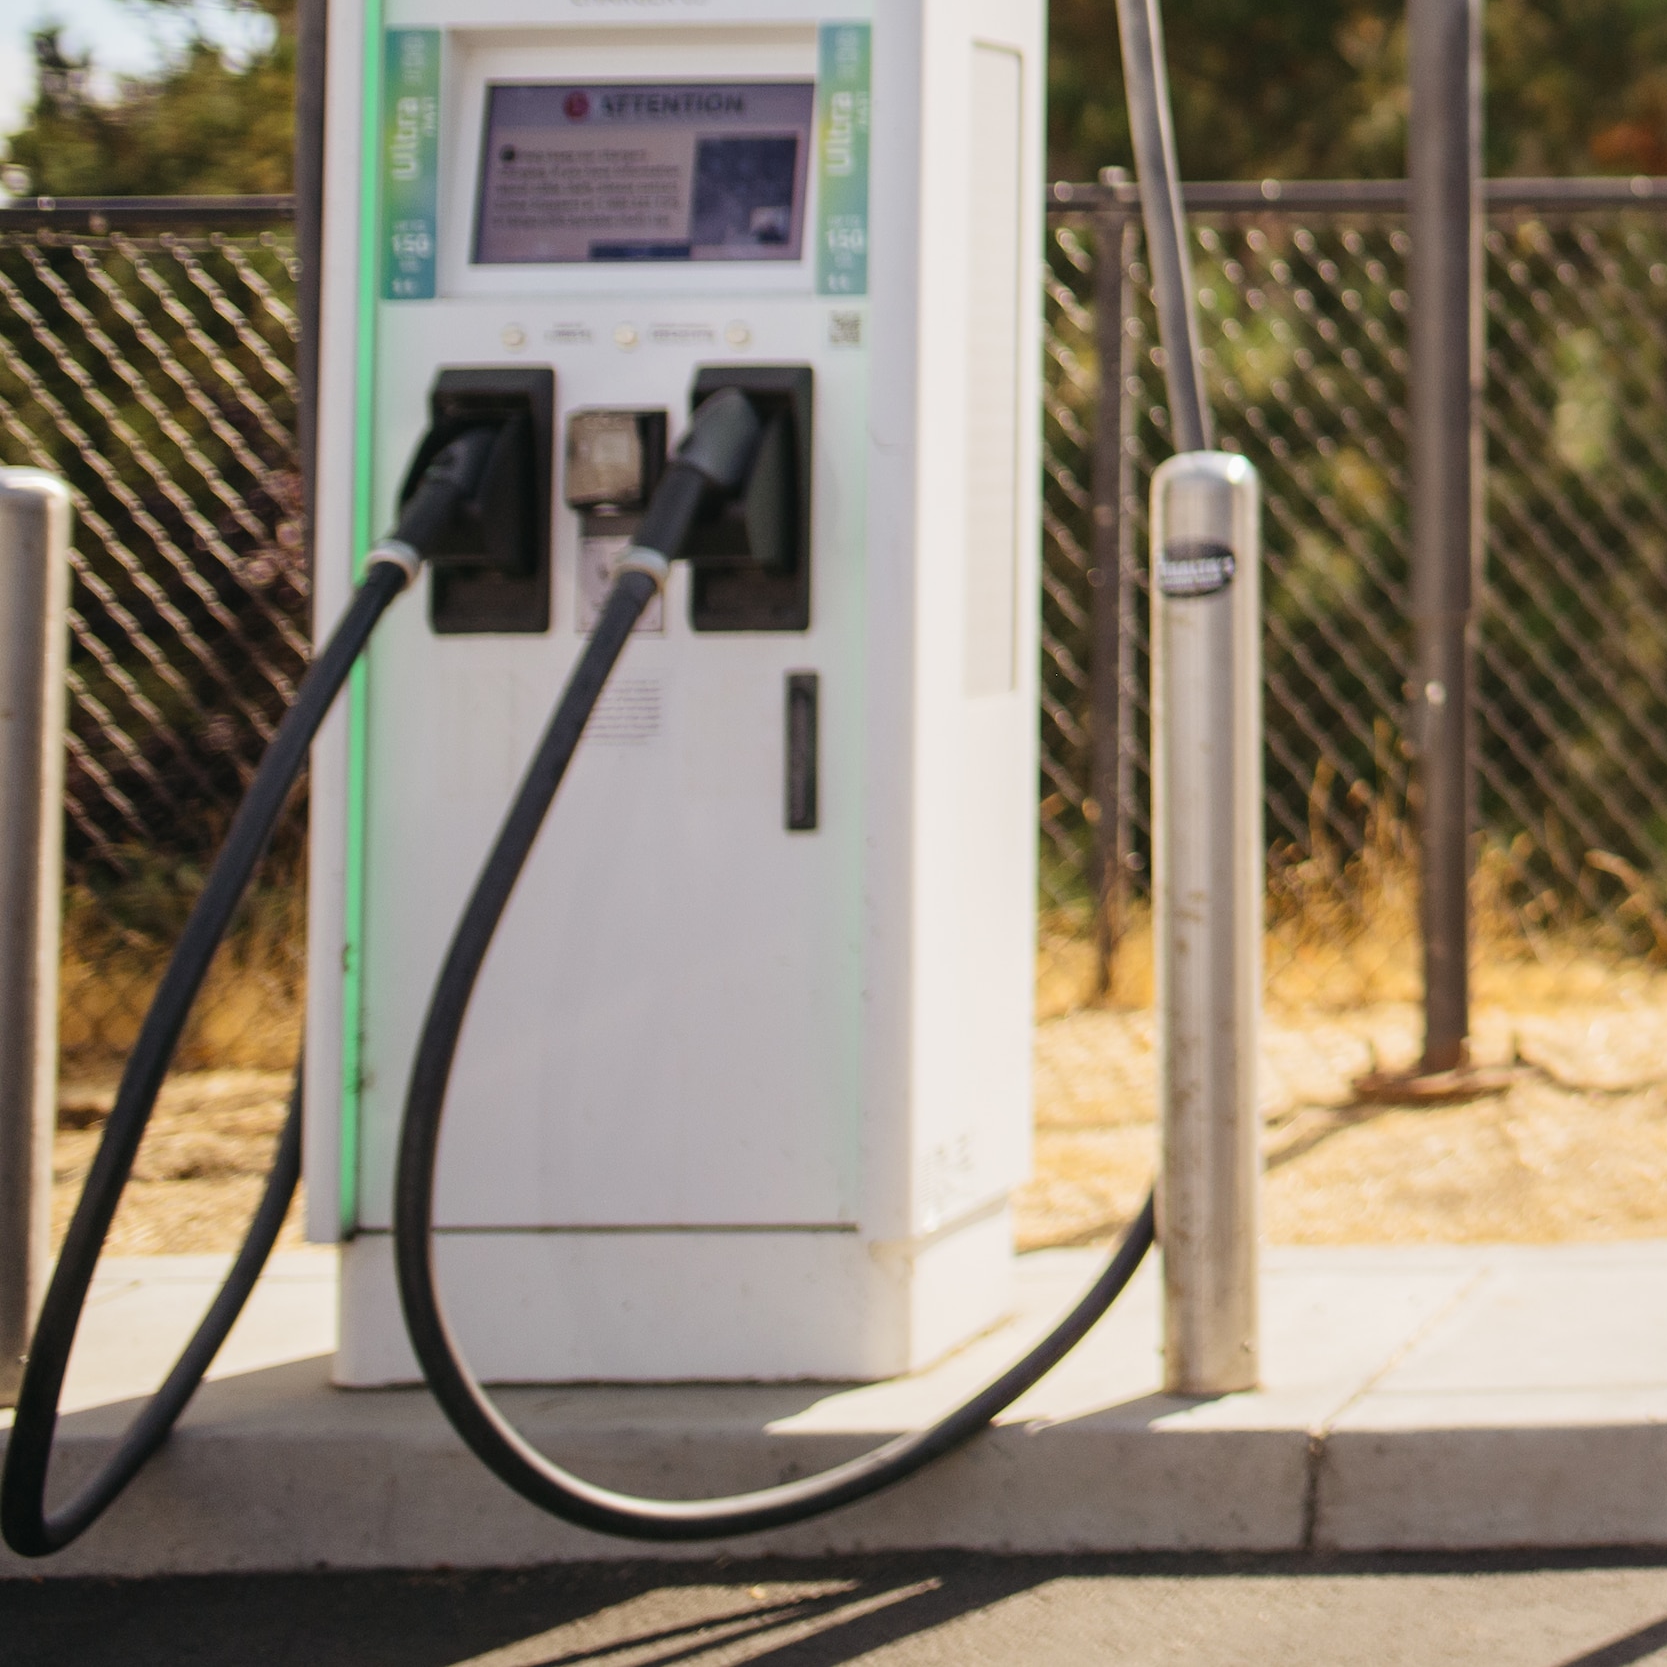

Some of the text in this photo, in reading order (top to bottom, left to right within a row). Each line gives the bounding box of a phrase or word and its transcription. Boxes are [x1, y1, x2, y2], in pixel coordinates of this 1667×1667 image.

[391, 97, 420, 179] Ultra
[600, 93, 745, 120] ATTENTION
[825, 91, 853, 176] Ultra
